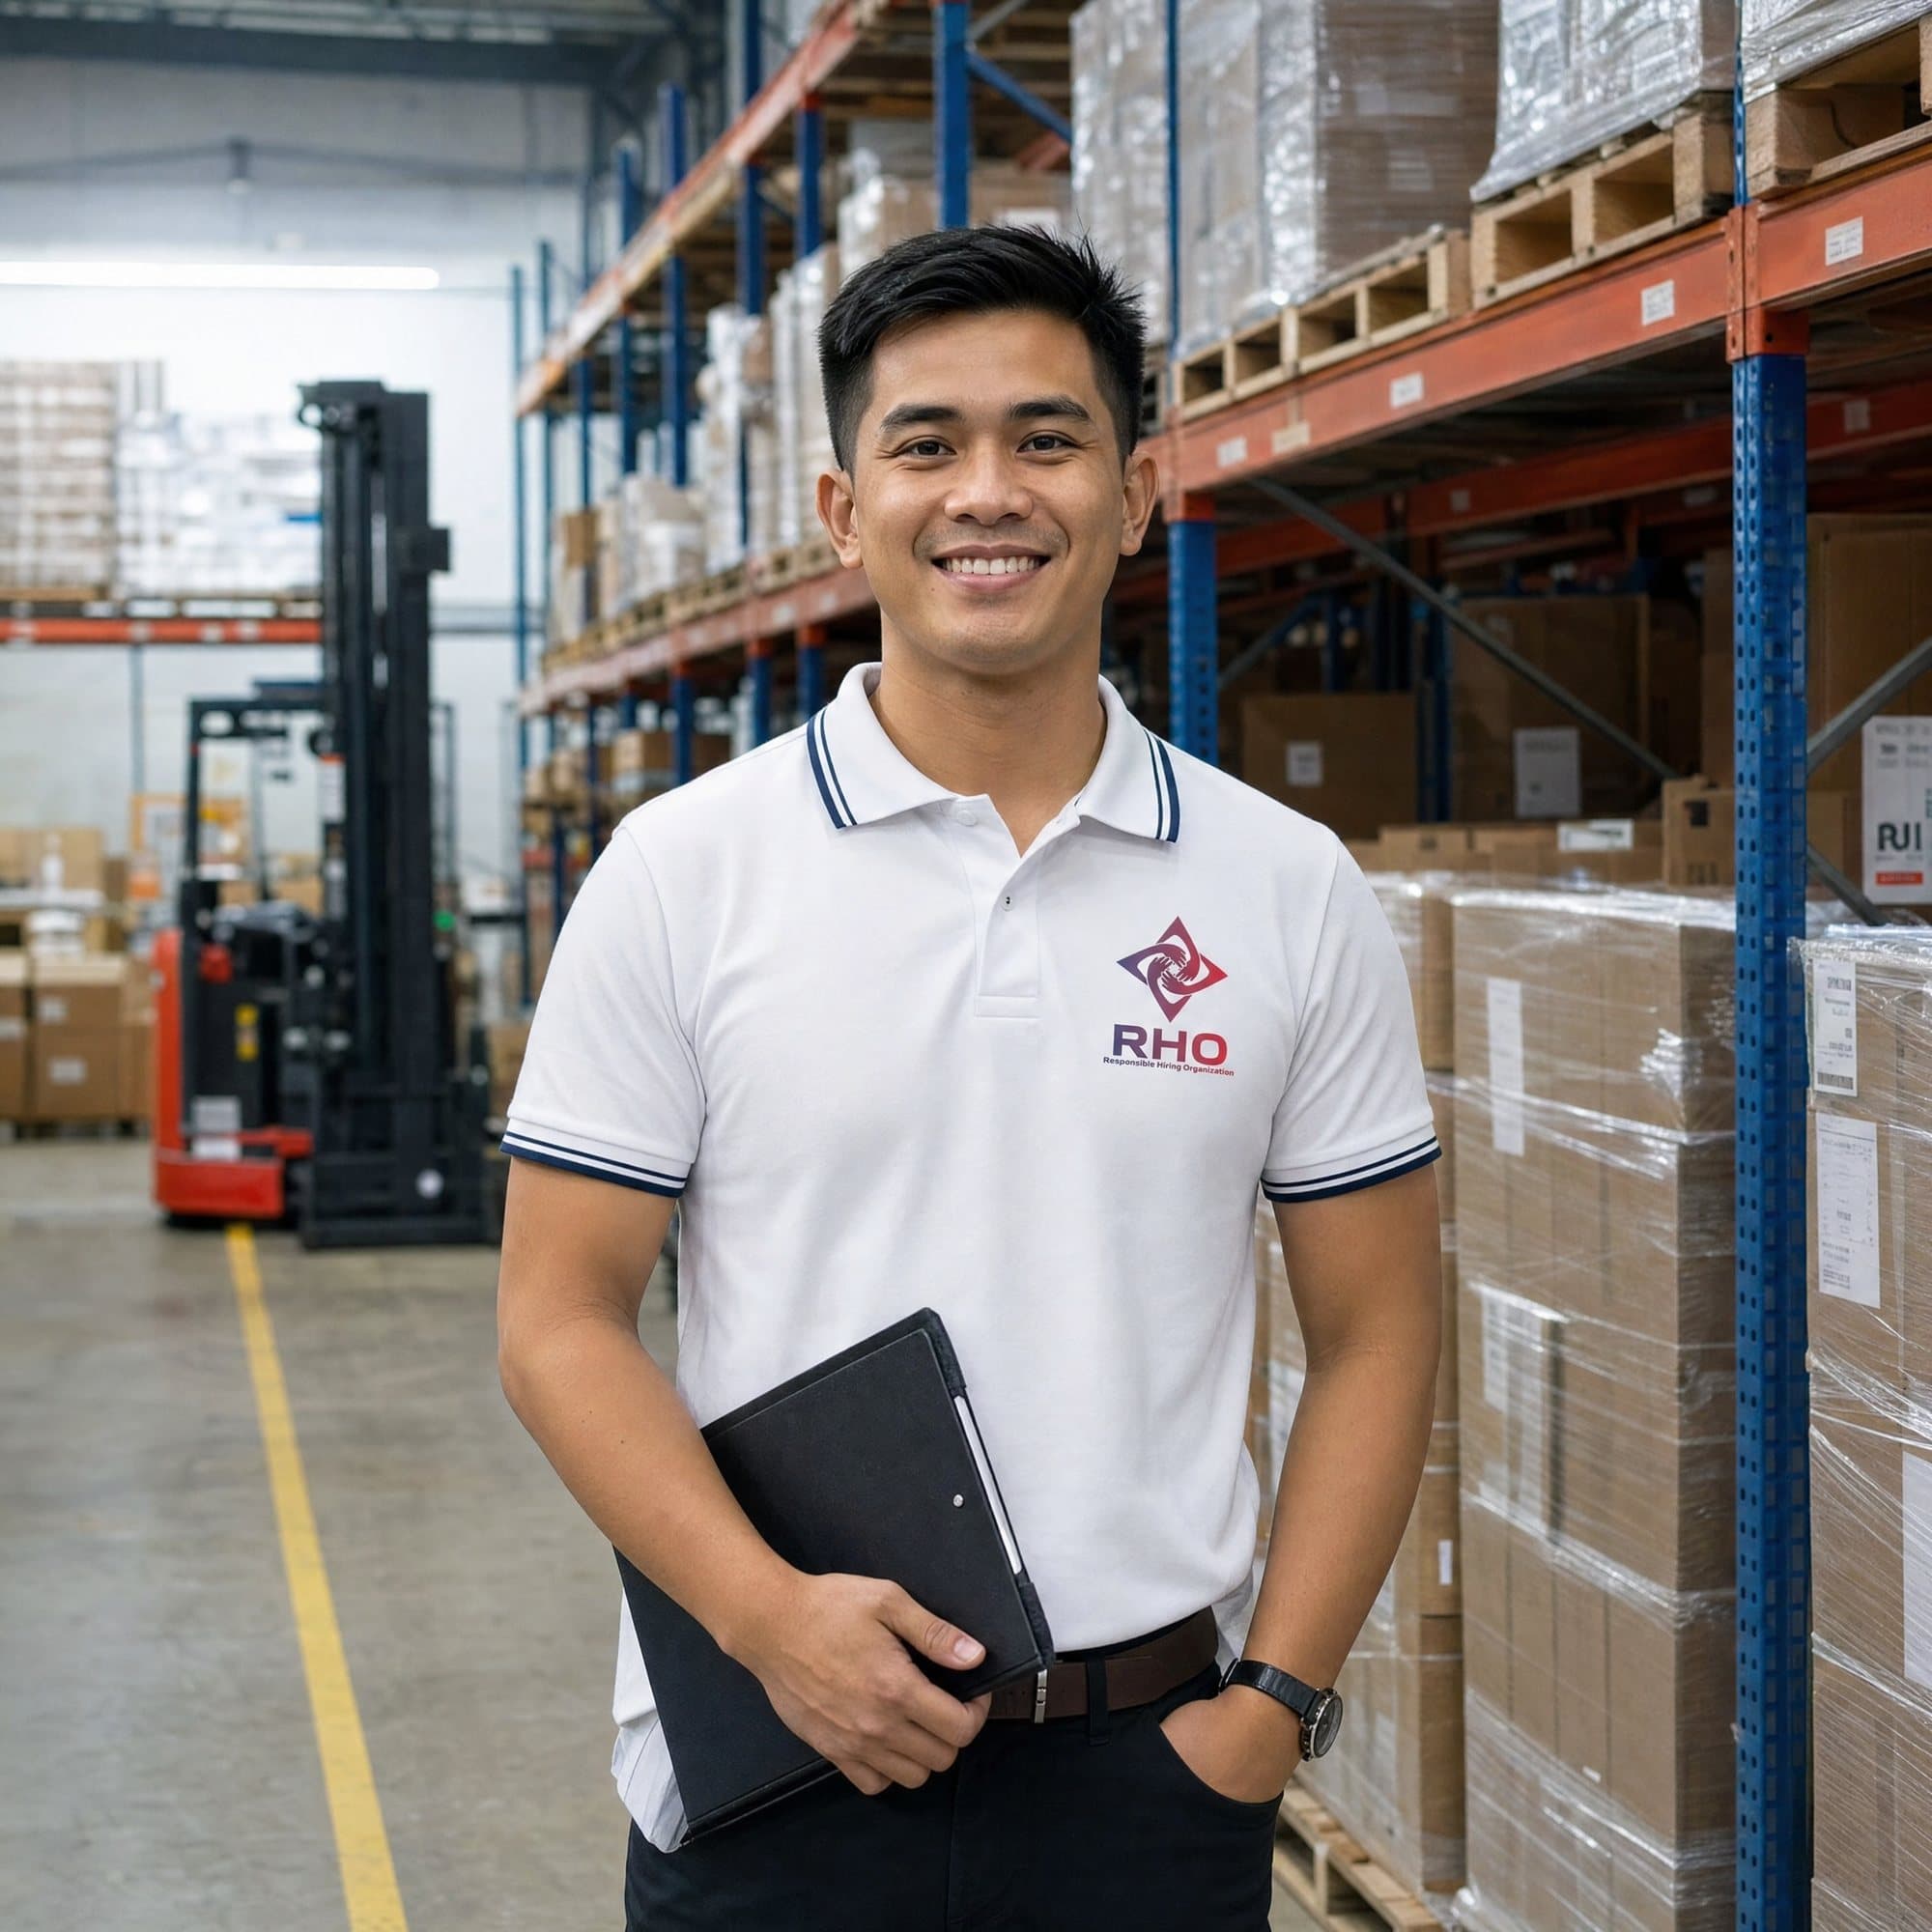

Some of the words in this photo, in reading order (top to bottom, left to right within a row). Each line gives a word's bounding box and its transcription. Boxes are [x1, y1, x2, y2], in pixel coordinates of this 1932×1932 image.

[1113, 1024, 1228, 1065] RHO
[1103, 1056, 1155, 1068] Responsible
[1156, 1061, 1181, 1072] Hiring
[1182, 1064, 1235, 1077] Organization
